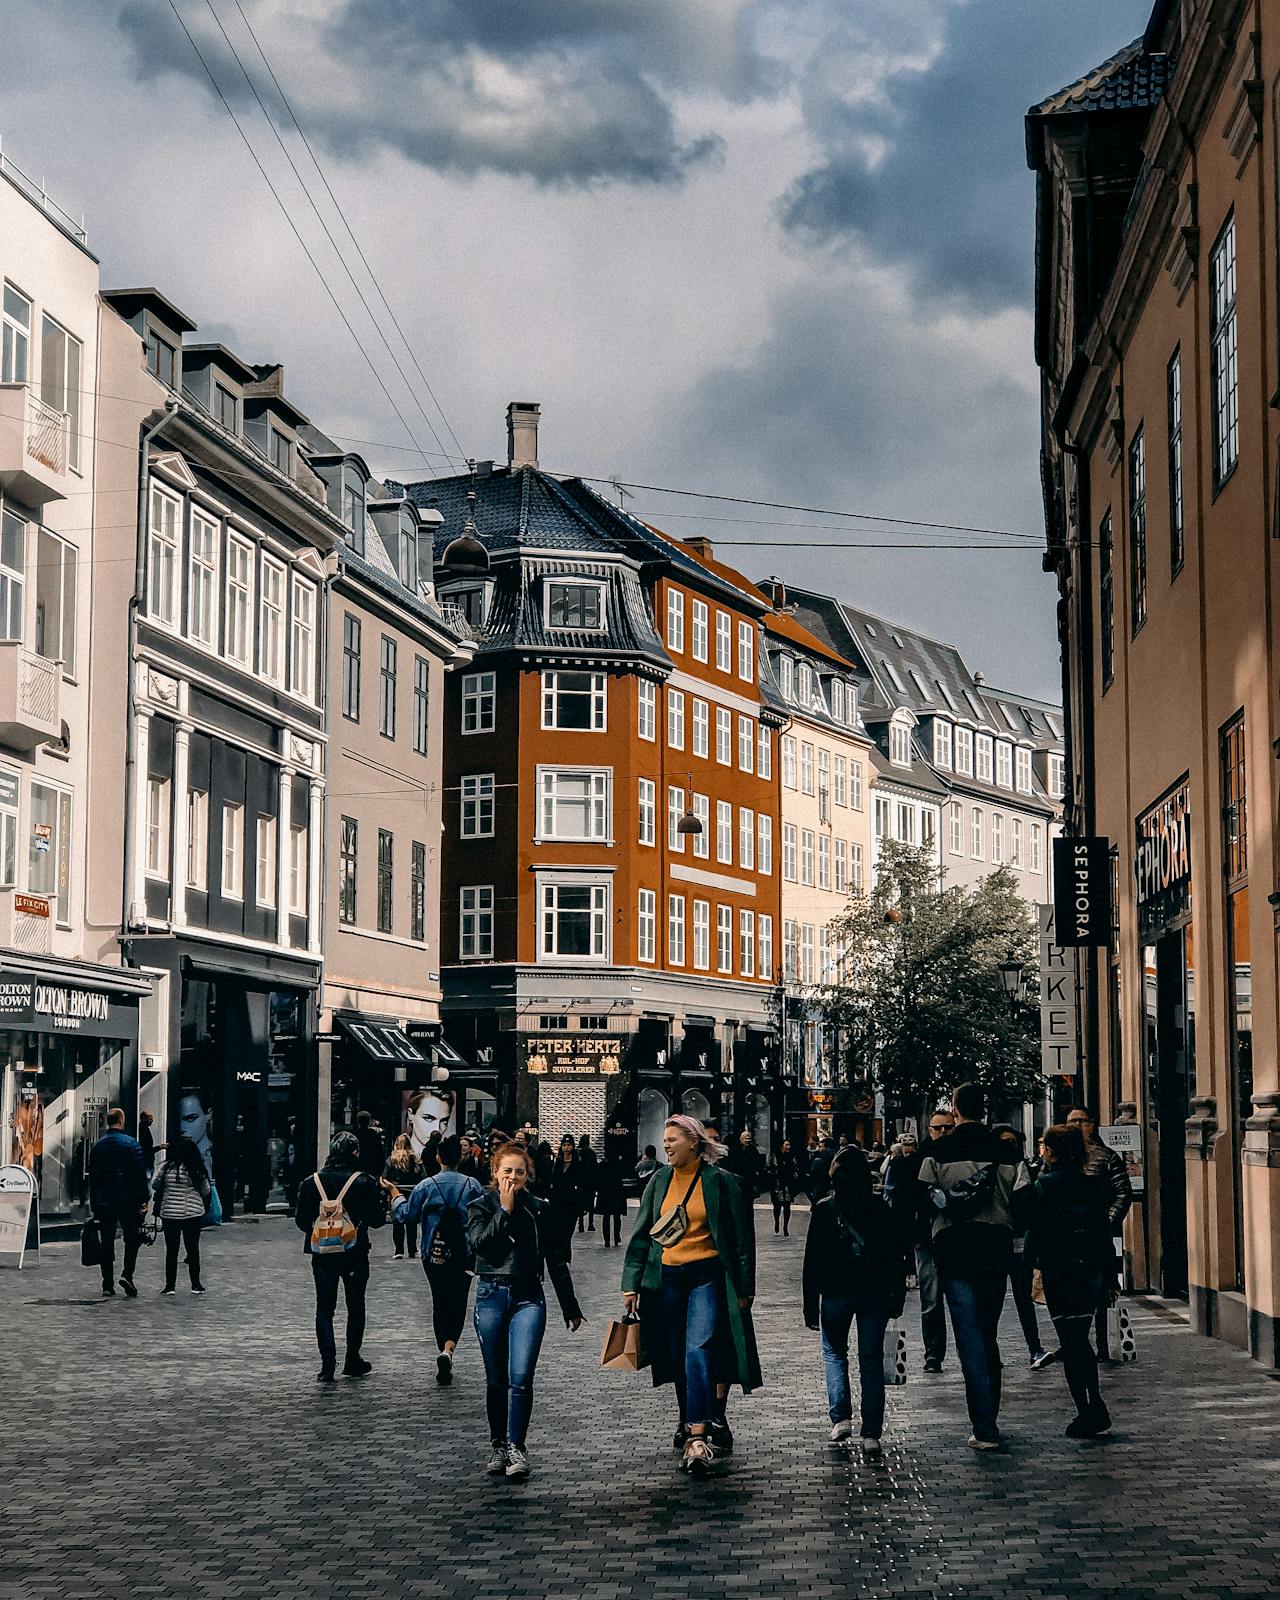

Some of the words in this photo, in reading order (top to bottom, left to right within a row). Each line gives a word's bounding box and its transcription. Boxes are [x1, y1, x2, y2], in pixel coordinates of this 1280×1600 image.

[1138, 812, 1189, 904] EPHORA
[1074, 845, 1090, 938] SEPHORA
[34, 901, 49, 912] CITY
[0, 984, 31, 995] OLTON
[0, 995, 31, 1007] ROWN
[34, 985, 68, 1015] OLTON
[68, 989, 109, 1020] BROWN
[54, 1016, 80, 1028] LONDON
[527, 1039, 573, 1054] PETER
[577, 1039, 621, 1054] HERTZ
[476, 1046, 494, 1063] NÜ
[236, 1071, 262, 1082] MAC
